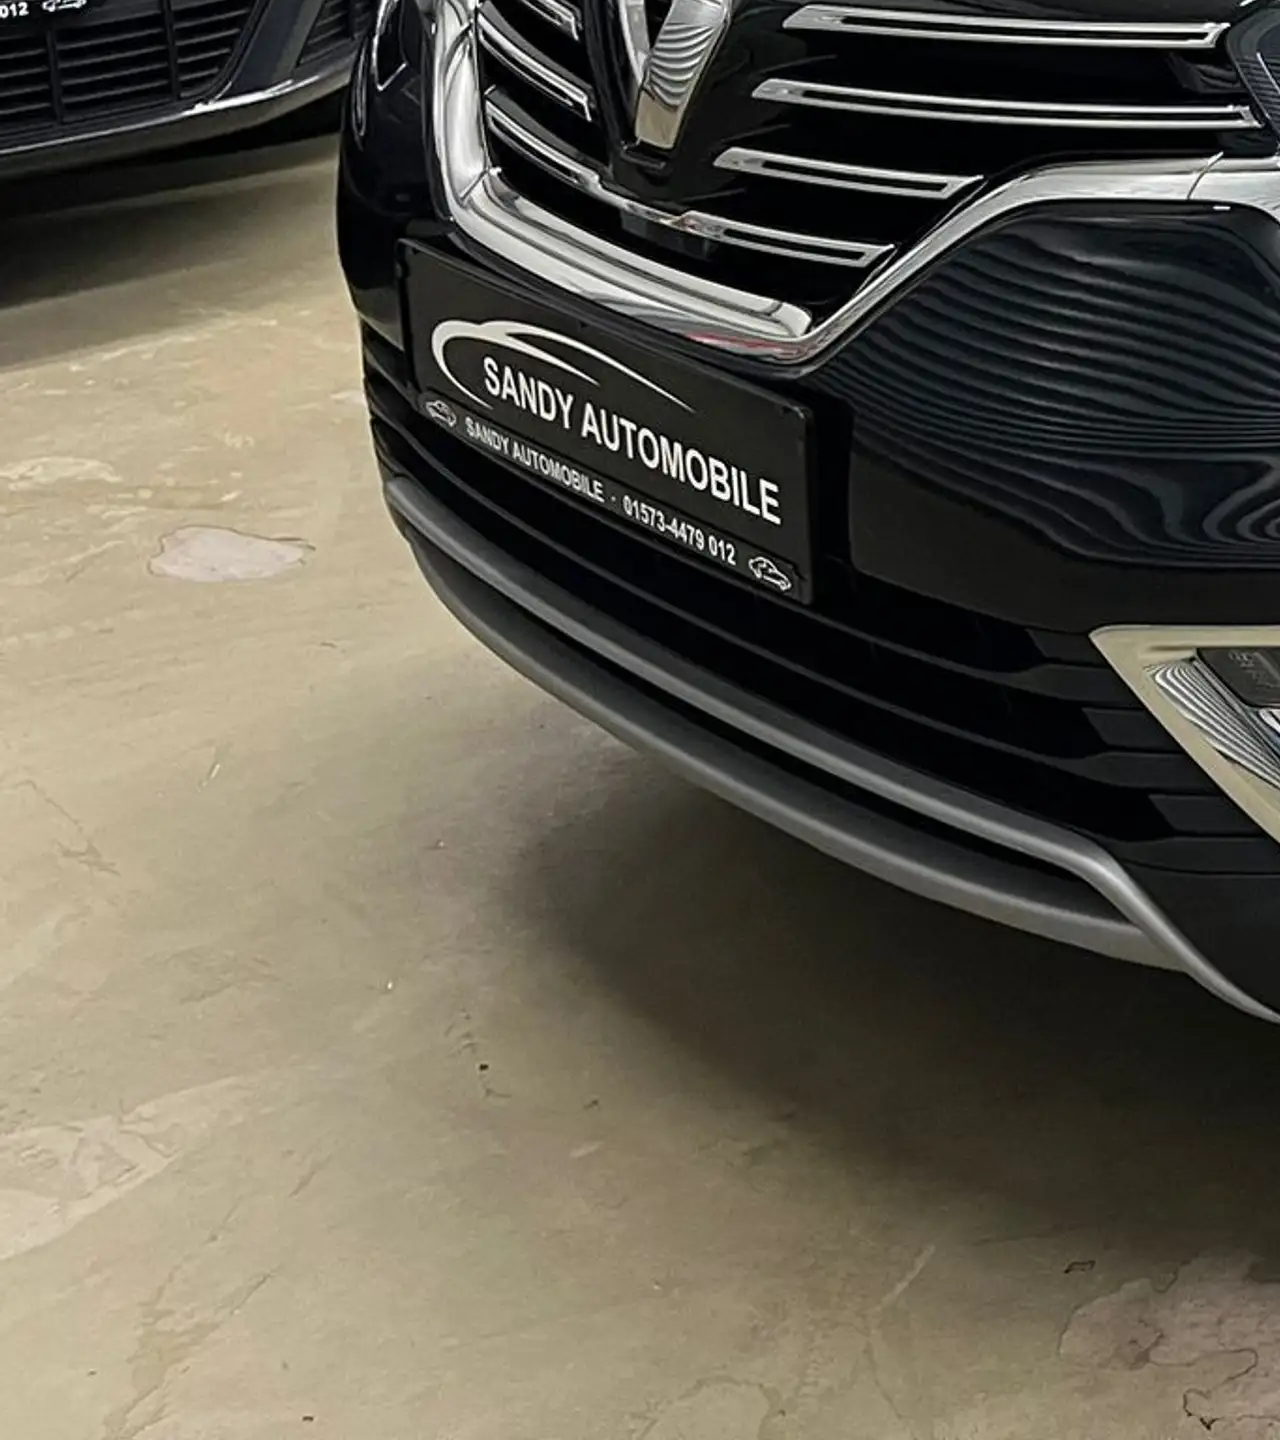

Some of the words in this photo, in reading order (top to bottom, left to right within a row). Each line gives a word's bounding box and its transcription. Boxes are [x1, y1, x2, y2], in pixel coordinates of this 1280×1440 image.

[0, 1, 29, 19] 012
[465, 416, 510, 455] SANDY
[512, 441, 605, 503] AUTOMOBILE
[622, 494, 705, 551] 01573-4479
[708, 535, 737, 566] 012
[483, 356, 574, 429] SANDY
[581, 402, 782, 525] AUTOMOBILE
